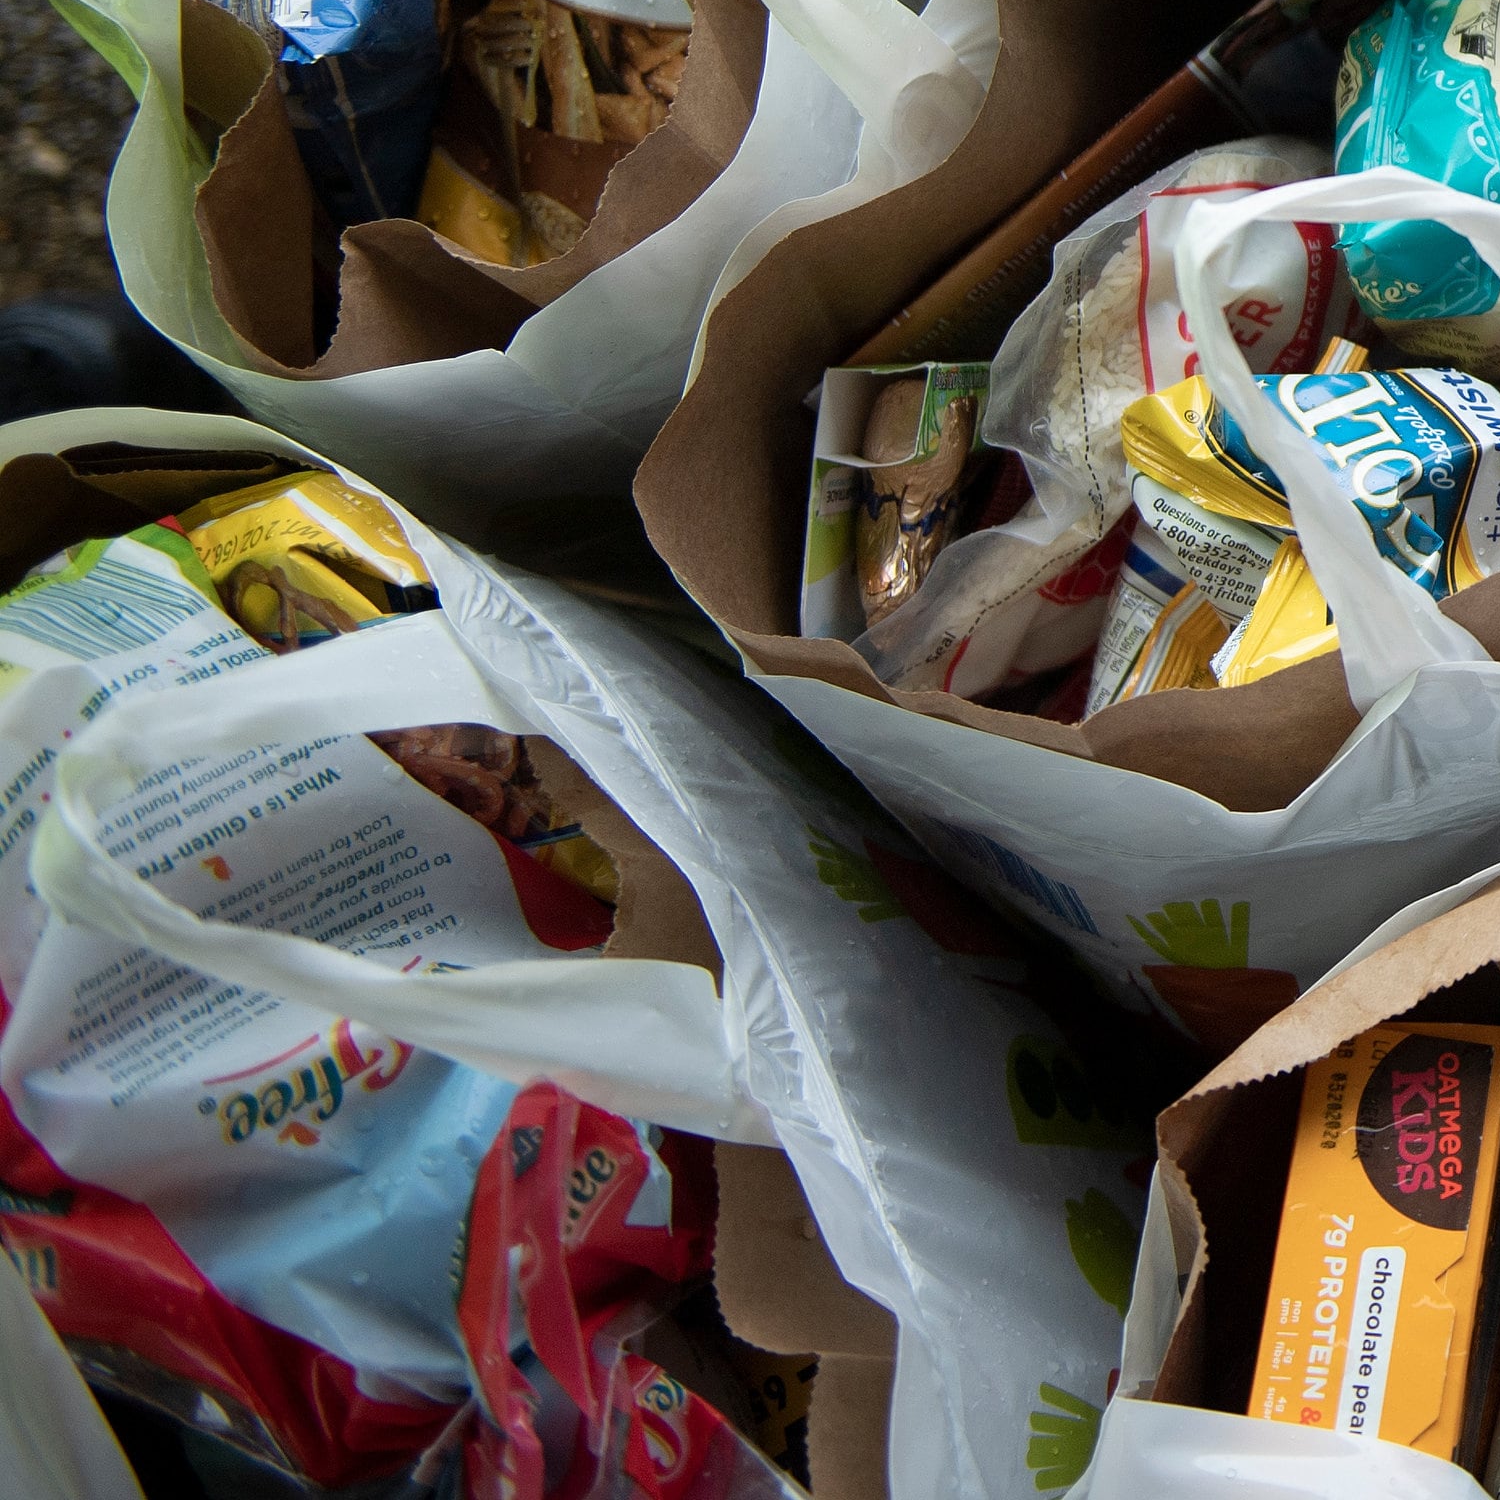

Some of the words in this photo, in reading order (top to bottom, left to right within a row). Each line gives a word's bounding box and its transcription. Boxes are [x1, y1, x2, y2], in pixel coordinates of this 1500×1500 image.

[1299, 239, 1322, 340] PACKAGE
[1390, 405, 1455, 491] Pretzels
[1151, 496, 1202, 531] Questions
[1203, 524, 1218, 538] or
[1176, 546, 1243, 577] Weekdays
[1189, 565, 1203, 577] to
[1203, 570, 1257, 596] 4:30pm
[183, 634, 226, 660] FREE
[119, 661, 159, 692] SOY
[175, 661, 218, 689] FREE
[78, 676, 121, 723] FREE
[179, 742, 258, 793] commonly
[248, 763, 279, 787] diet
[284, 765, 341, 801] What
[131, 788, 181, 824] found
[181, 774, 248, 821] excludes
[247, 802, 264, 822] a
[265, 791, 285, 813] is
[135, 804, 182, 839] foods
[352, 812, 393, 841] Look
[319, 827, 406, 883] alternatives
[328, 828, 352, 852] for
[387, 843, 419, 866] Our
[285, 842, 327, 873] them
[433, 851, 452, 869] to
[370, 859, 434, 895] provide
[386, 884, 426, 908] from
[314, 902, 384, 945] premium
[362, 916, 400, 941] each
[402, 901, 435, 926] that
[423, 912, 458, 939] Live
[1390, 1067, 1437, 1195] KIDS
[1323, 1212, 1354, 1248] 7g
[1279, 1297, 1292, 1325] gmo
[1291, 1299, 1304, 1324] non
[1358, 1256, 1393, 1378] chocolate
[1299, 1255, 1348, 1400] PROTEIN
[1282, 1347, 1297, 1365] 2g
[1299, 1405, 1322, 1425] &
